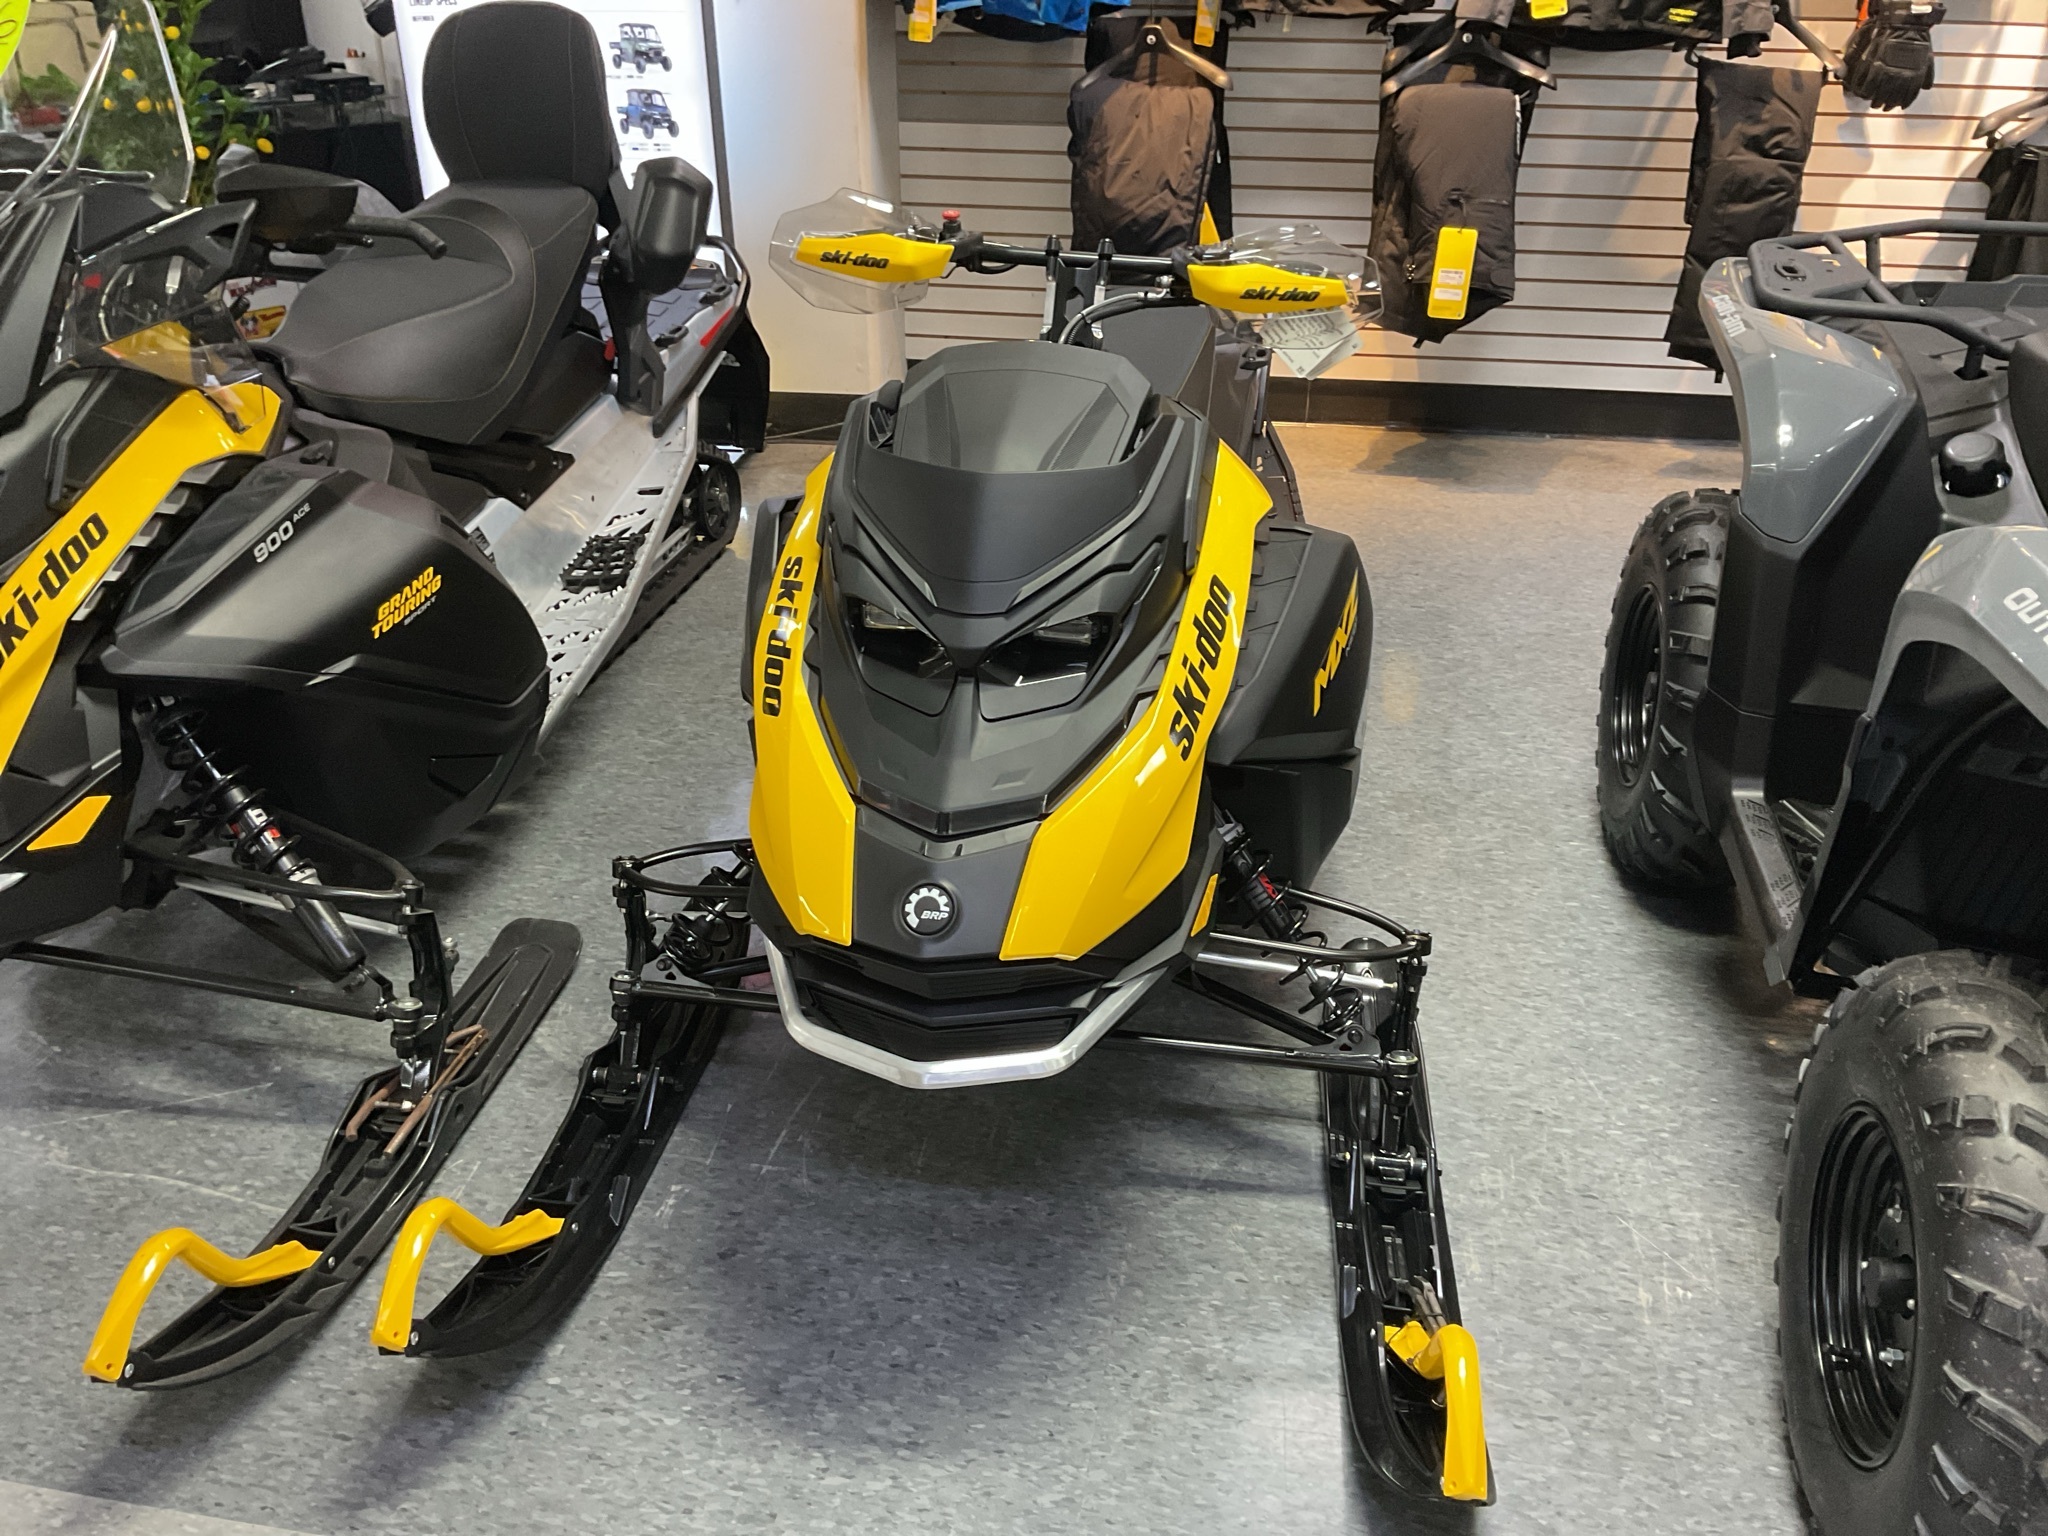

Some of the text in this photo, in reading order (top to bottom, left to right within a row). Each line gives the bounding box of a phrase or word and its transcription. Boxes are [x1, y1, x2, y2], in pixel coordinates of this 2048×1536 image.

[820, 250, 889, 269] ski-doo
[1240, 286, 1320, 302] ski-doo
[1712, 294, 1746, 337] can-am
[253, 503, 311, 563] 900 ACE
[0, 512, 109, 669] ki-doo
[371, 574, 442, 639] TOURING
[378, 566, 434, 621] GRAND
[403, 595, 437, 626] SPORT
[762, 556, 803, 717] ski-doo
[1169, 574, 1233, 761] ski-doo
[920, 910, 949, 920] BRP
